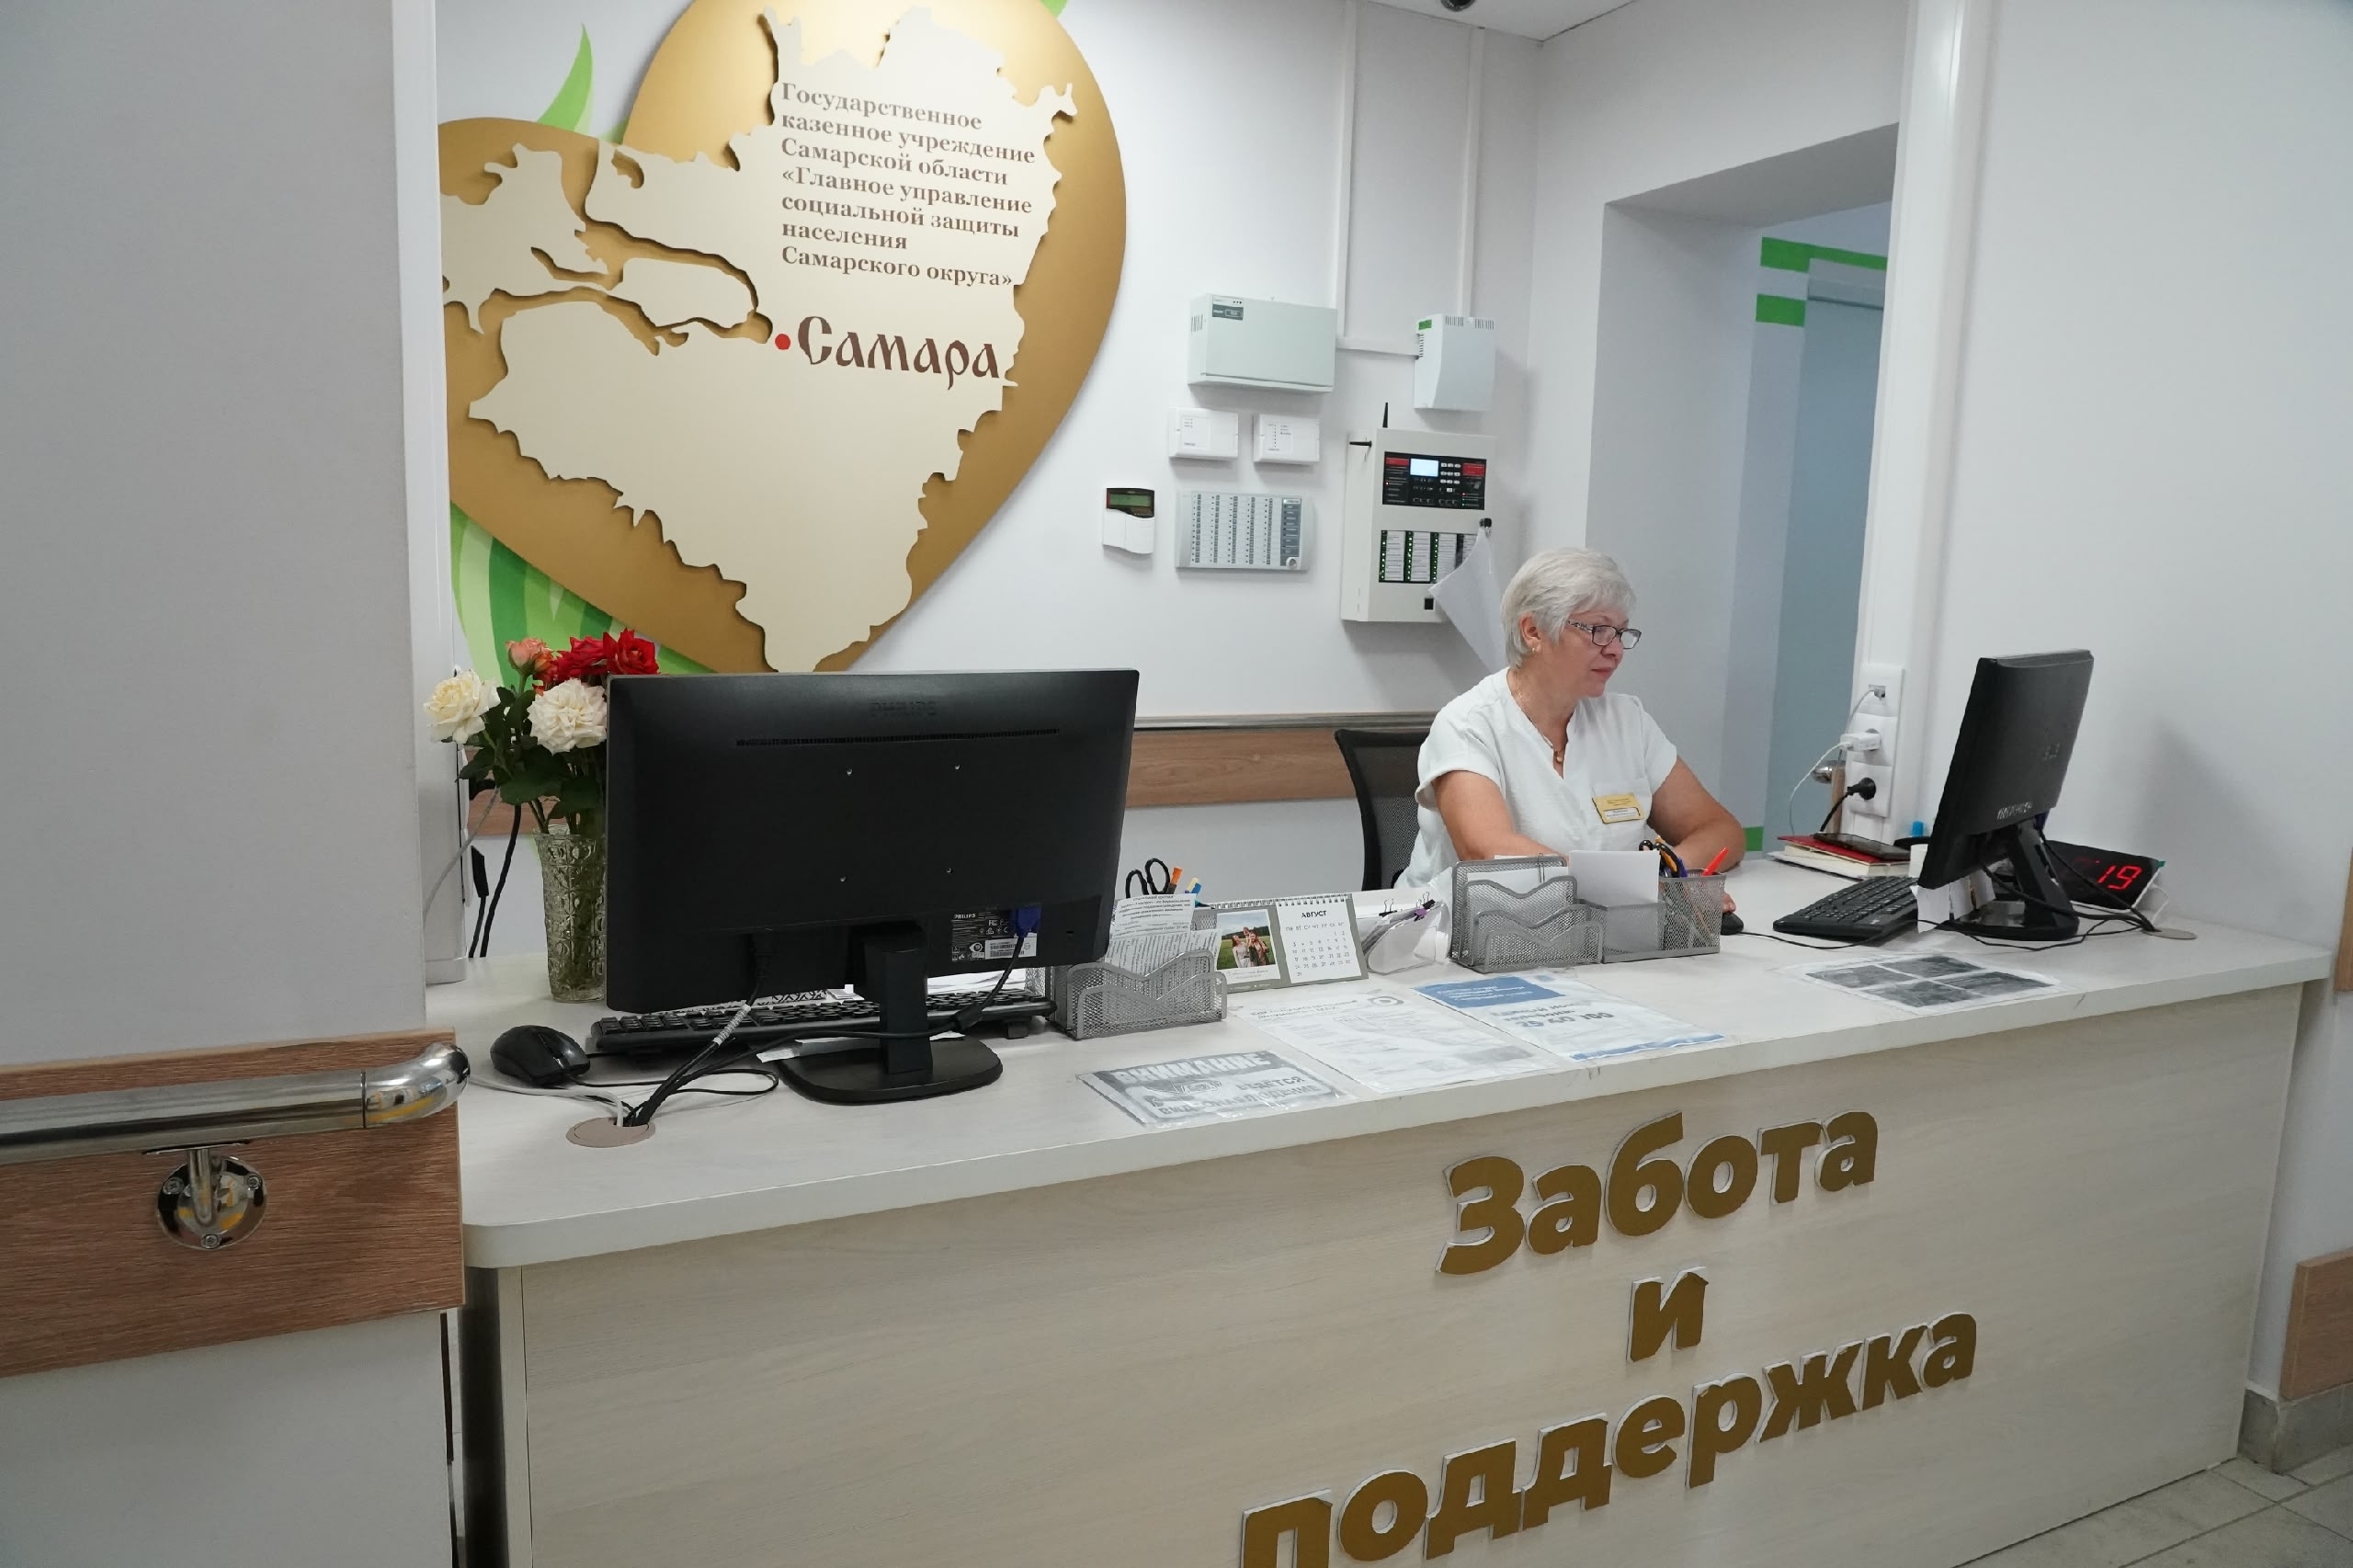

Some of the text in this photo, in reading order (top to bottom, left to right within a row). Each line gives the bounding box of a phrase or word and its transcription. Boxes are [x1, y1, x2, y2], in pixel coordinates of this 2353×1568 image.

[781, 82, 983, 131] Государственное
[781, 113, 1036, 165] казенное учреждение
[781, 137, 1008, 186] Самарской области
[782, 166, 1032, 214] «Главное управление
[781, 196, 1019, 238] социальной защиты
[781, 223, 908, 250] населения
[781, 246, 1012, 287] Самарского округа»
[798, 315, 1000, 391] Самара
[2097, 865, 2143, 890] 19
[1301, 910, 1327, 919] АВГУСТ
[1110, 1052, 1272, 1085] ВНИМАНИЕ
[1158, 1085, 1322, 1116] ВИДОНАБЛЮДЕНИЕ
[1435, 1109, 1880, 1276] Забота
[1626, 1266, 1711, 1364] и
[1241, 1311, 1978, 1568] поддержка
